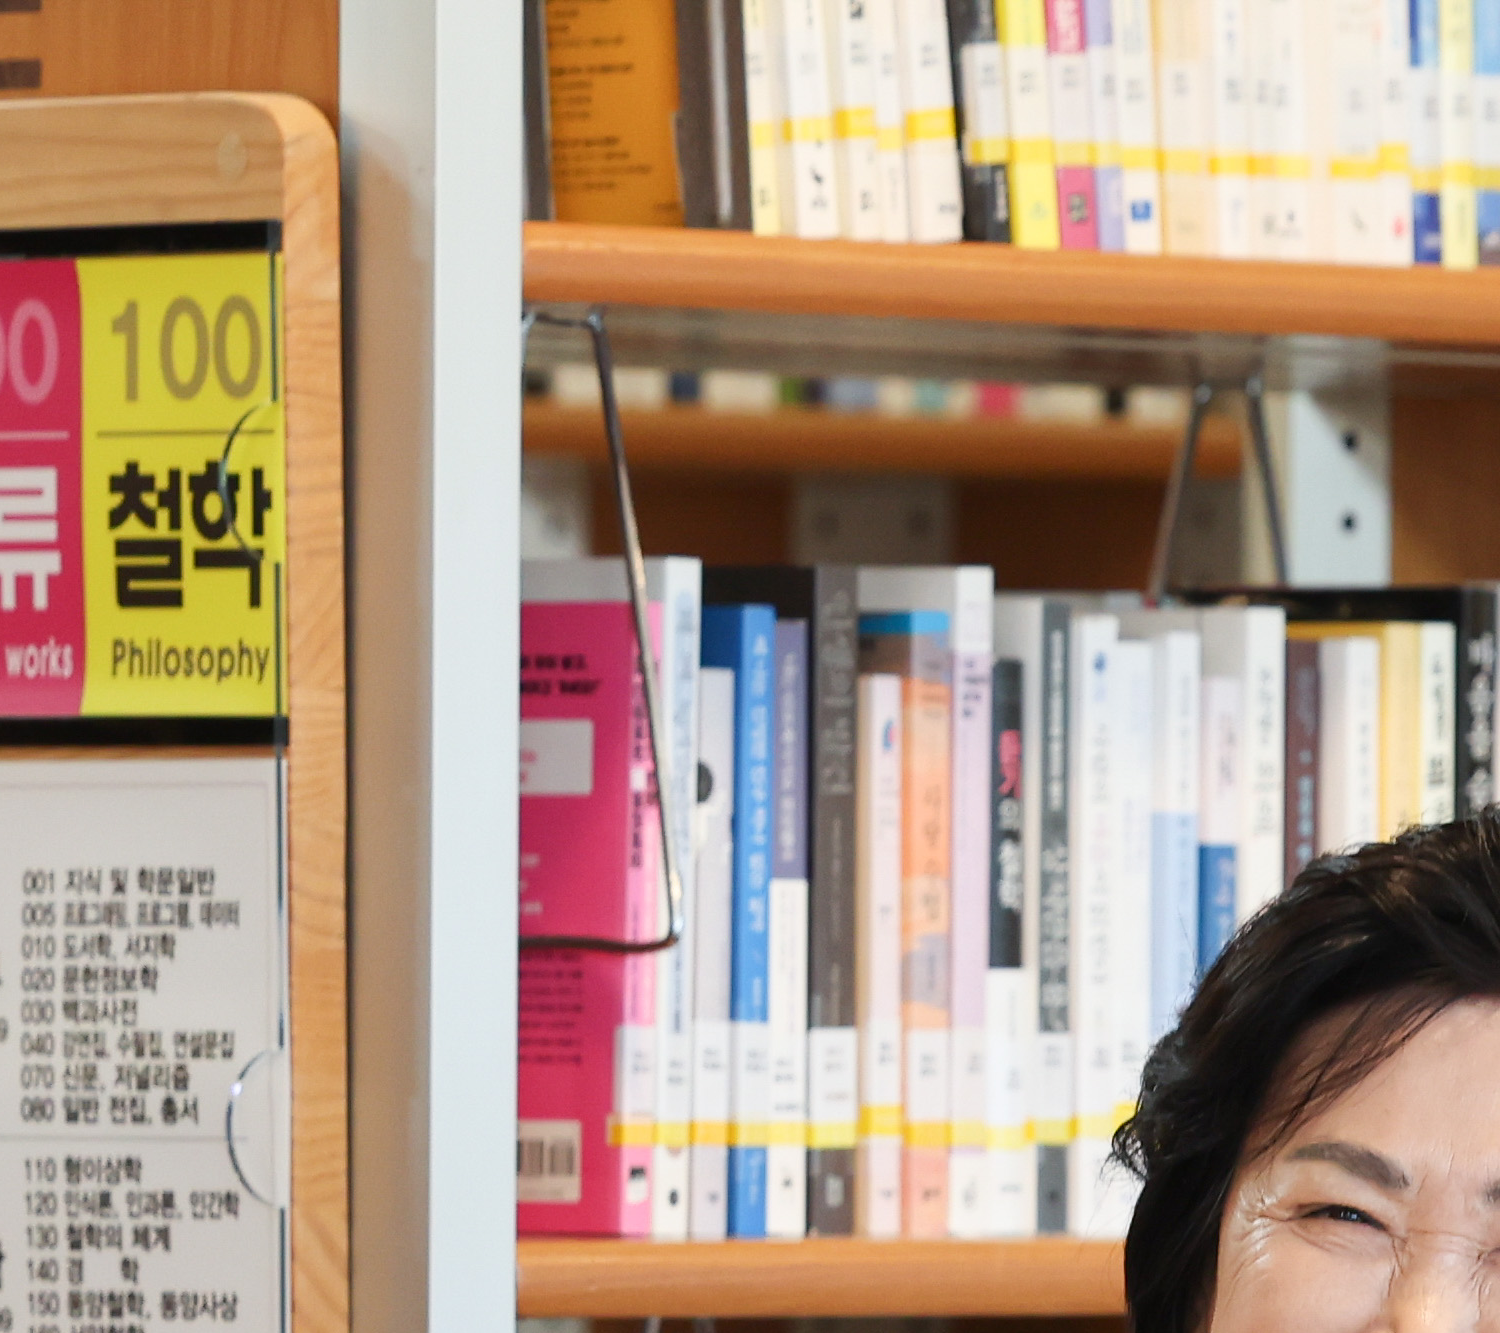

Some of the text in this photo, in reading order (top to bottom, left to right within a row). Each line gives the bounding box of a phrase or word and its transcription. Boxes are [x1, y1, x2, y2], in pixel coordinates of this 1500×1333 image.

[110, 294, 262, 401] 100
[110, 461, 271, 610] 철학
[6, 638, 73, 681] works
[111, 638, 270, 684] Philosophy
[23, 870, 54, 895] 001
[65, 870, 102, 895] 지식
[21, 934, 56, 961] 010
[21, 967, 56, 993] 020
[24, 1157, 58, 1183] 110
